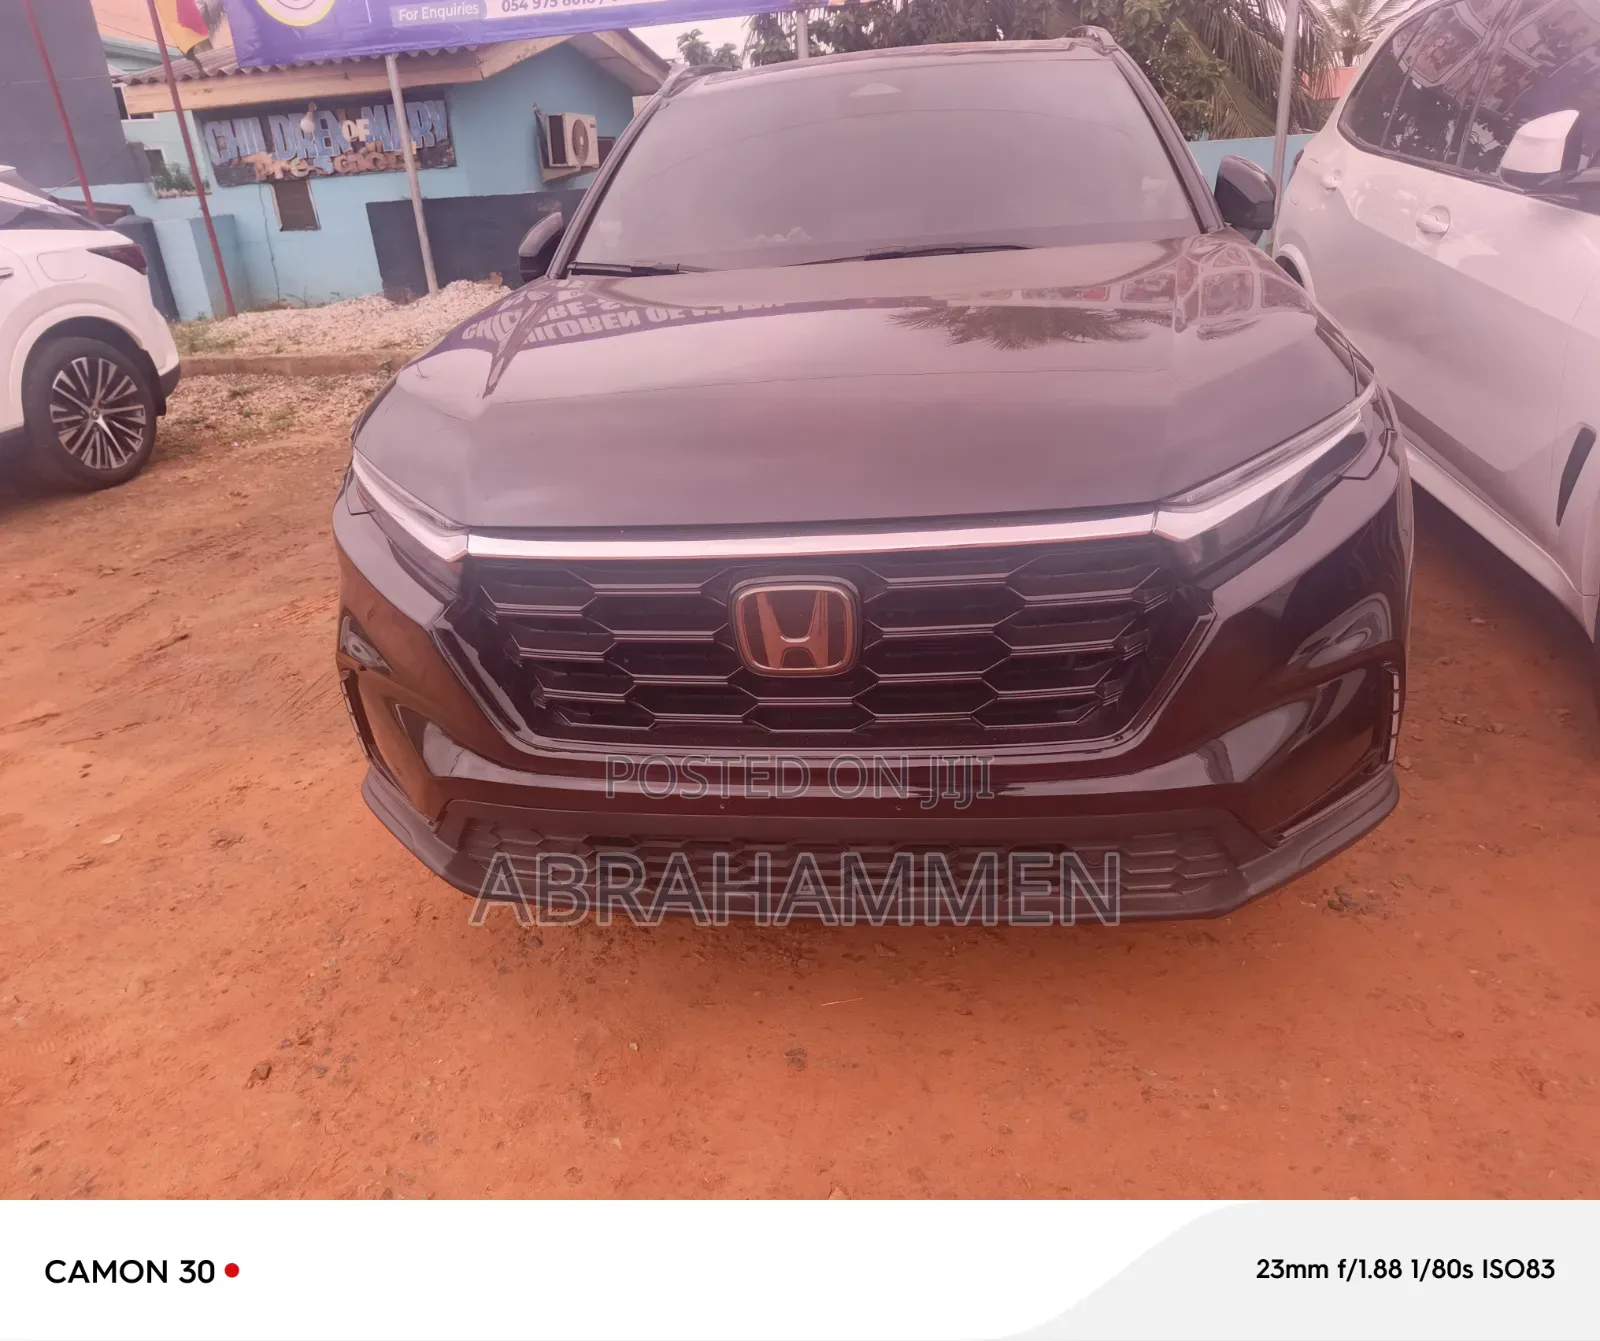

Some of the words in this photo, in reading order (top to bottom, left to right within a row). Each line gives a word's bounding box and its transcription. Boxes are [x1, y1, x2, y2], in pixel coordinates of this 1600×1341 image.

[399, 8, 418, 21] For
[421, 2, 480, 20] Enquiries
[501, 0, 528, 12] 054
[203, 110, 353, 165] CHILDREN
[342, 119, 369, 143] OF
